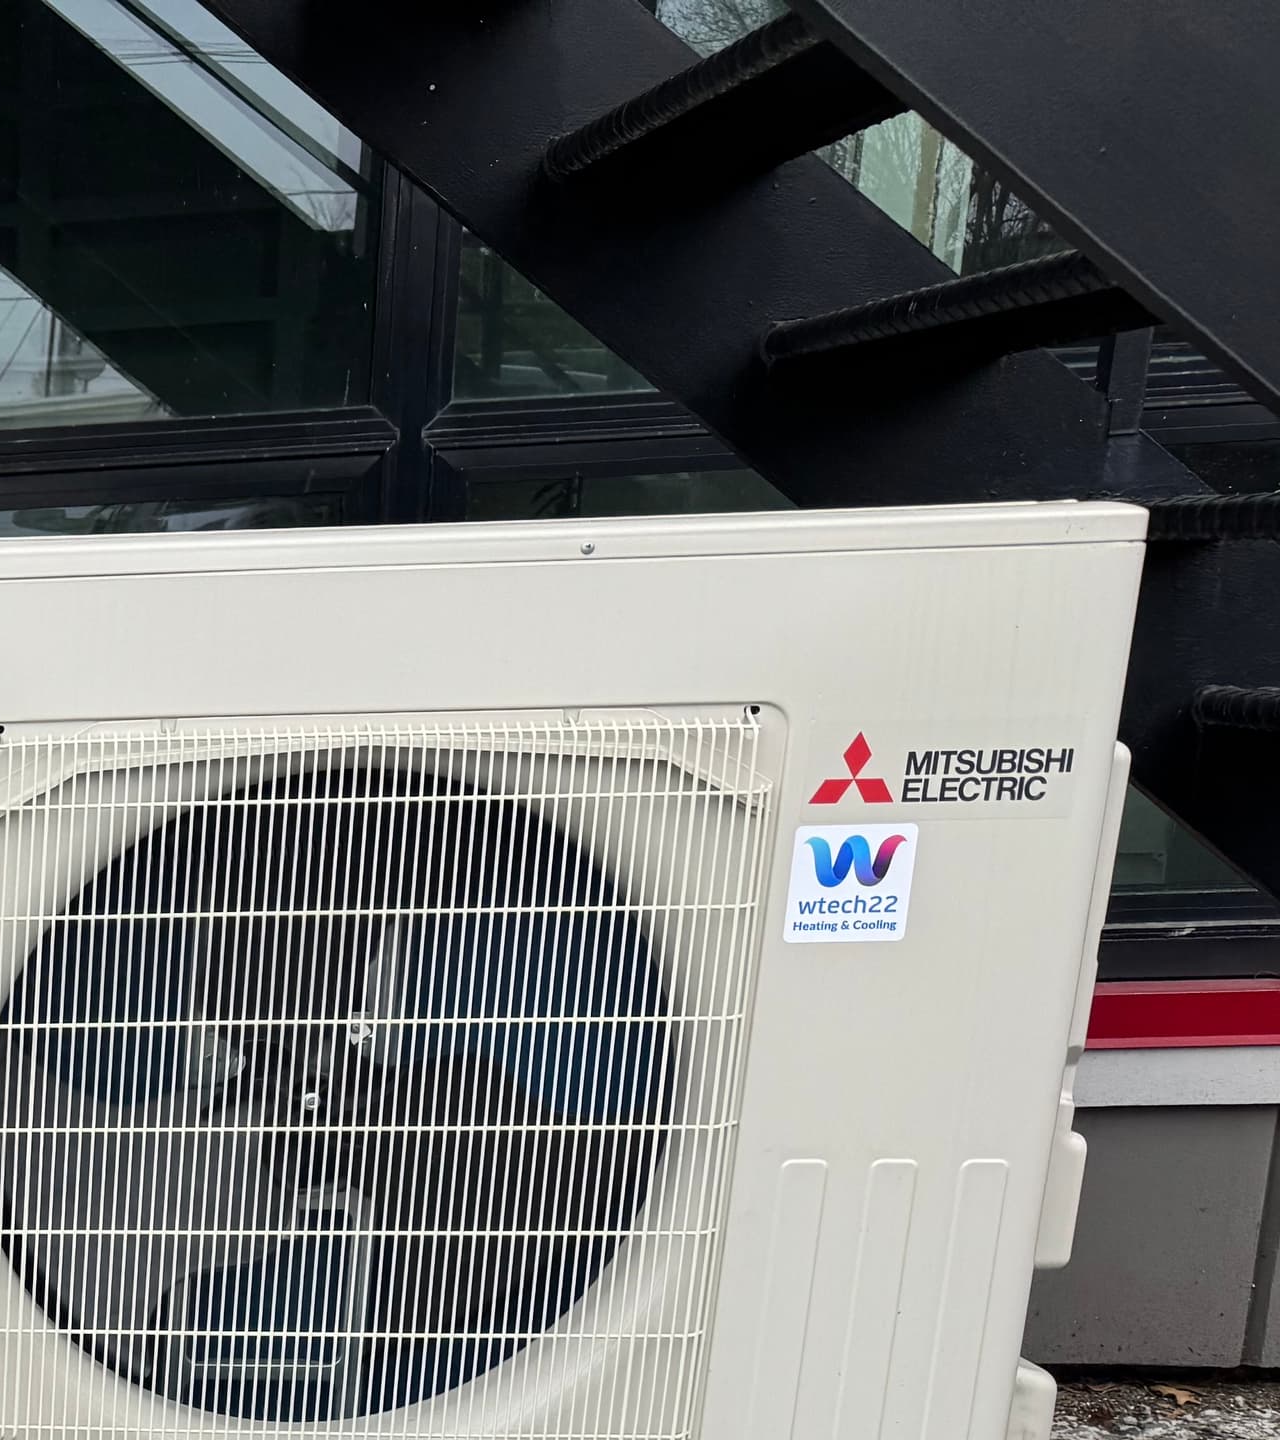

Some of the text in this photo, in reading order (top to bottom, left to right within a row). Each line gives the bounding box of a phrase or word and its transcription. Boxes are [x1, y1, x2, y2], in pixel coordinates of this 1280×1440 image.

[905, 748, 1075, 776] MITSUBISHI
[901, 775, 1048, 803] ELECTRIC
[798, 894, 898, 915] wtech22
[792, 919, 897, 932] Heating & Cooling
